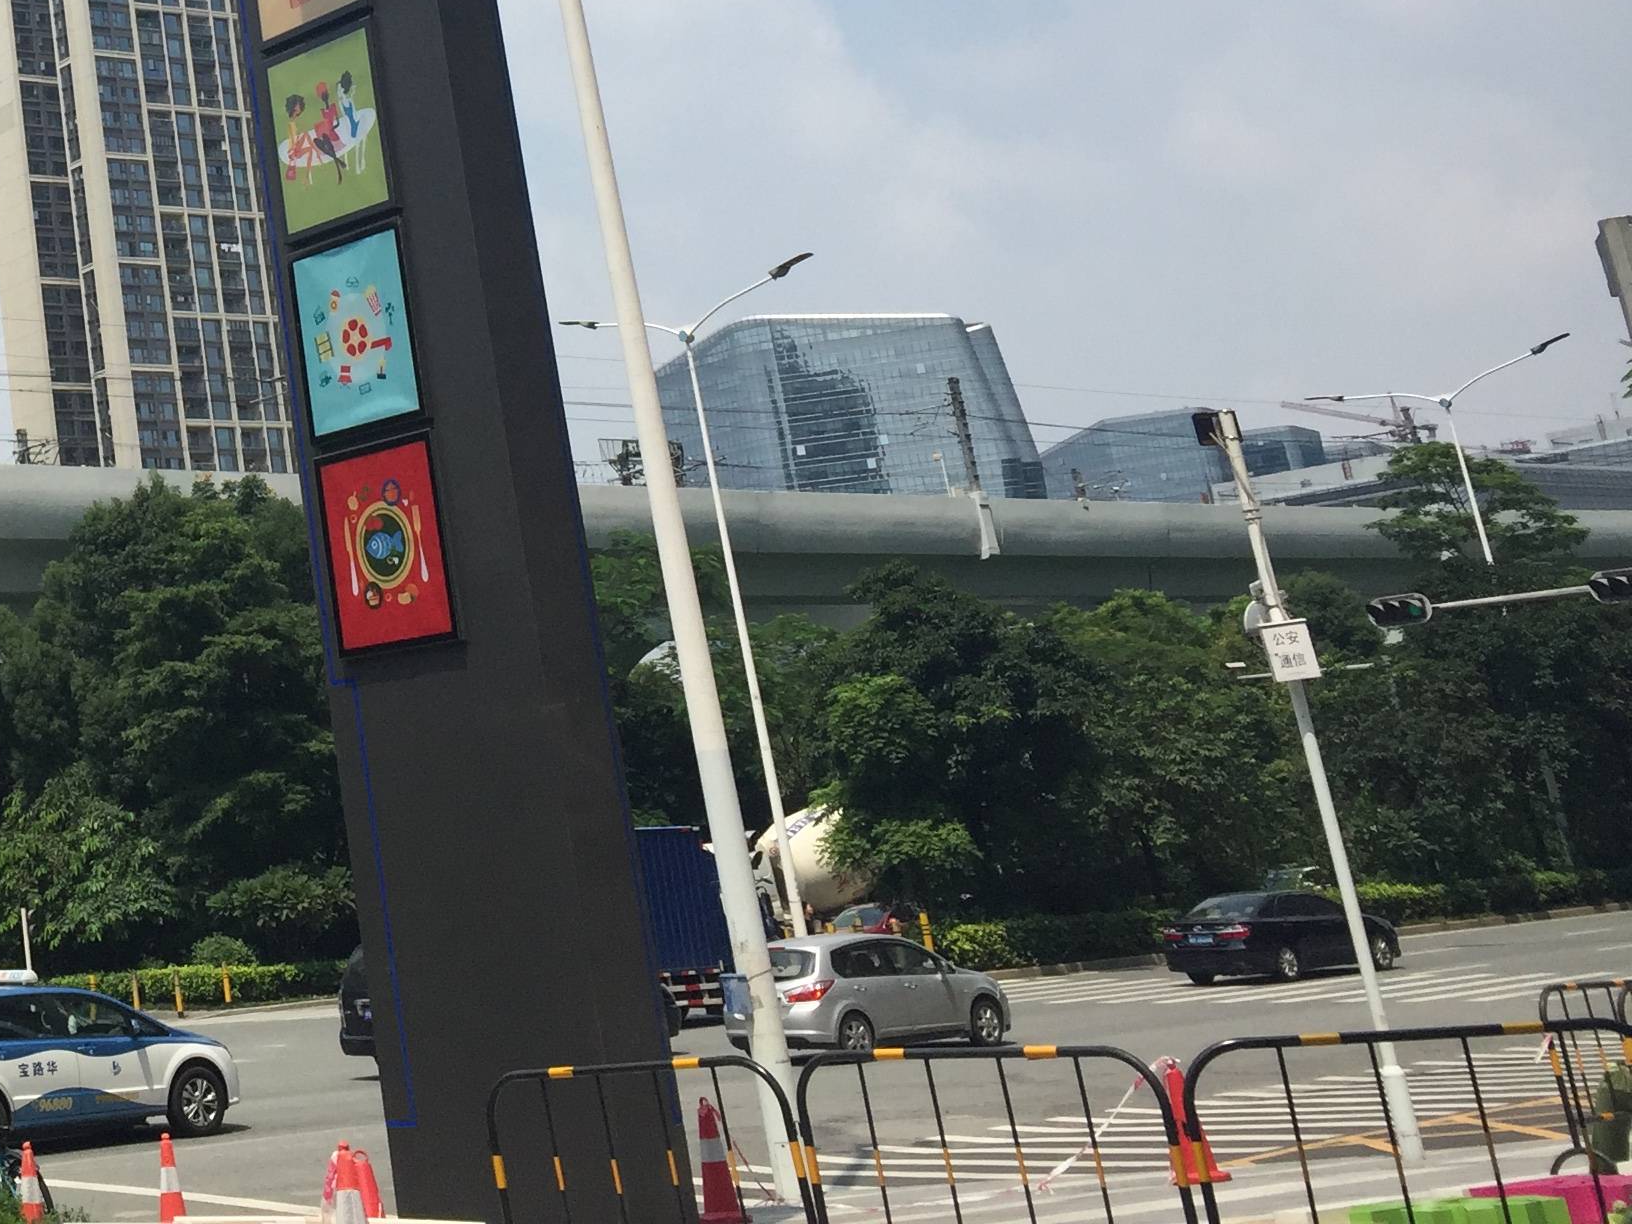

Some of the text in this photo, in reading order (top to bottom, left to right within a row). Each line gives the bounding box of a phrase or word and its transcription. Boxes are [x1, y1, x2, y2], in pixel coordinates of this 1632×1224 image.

[1272, 630, 1300, 646] 公安
[1278, 652, 1308, 669] 通信
[18, 1060, 59, 1078] 宝路华
